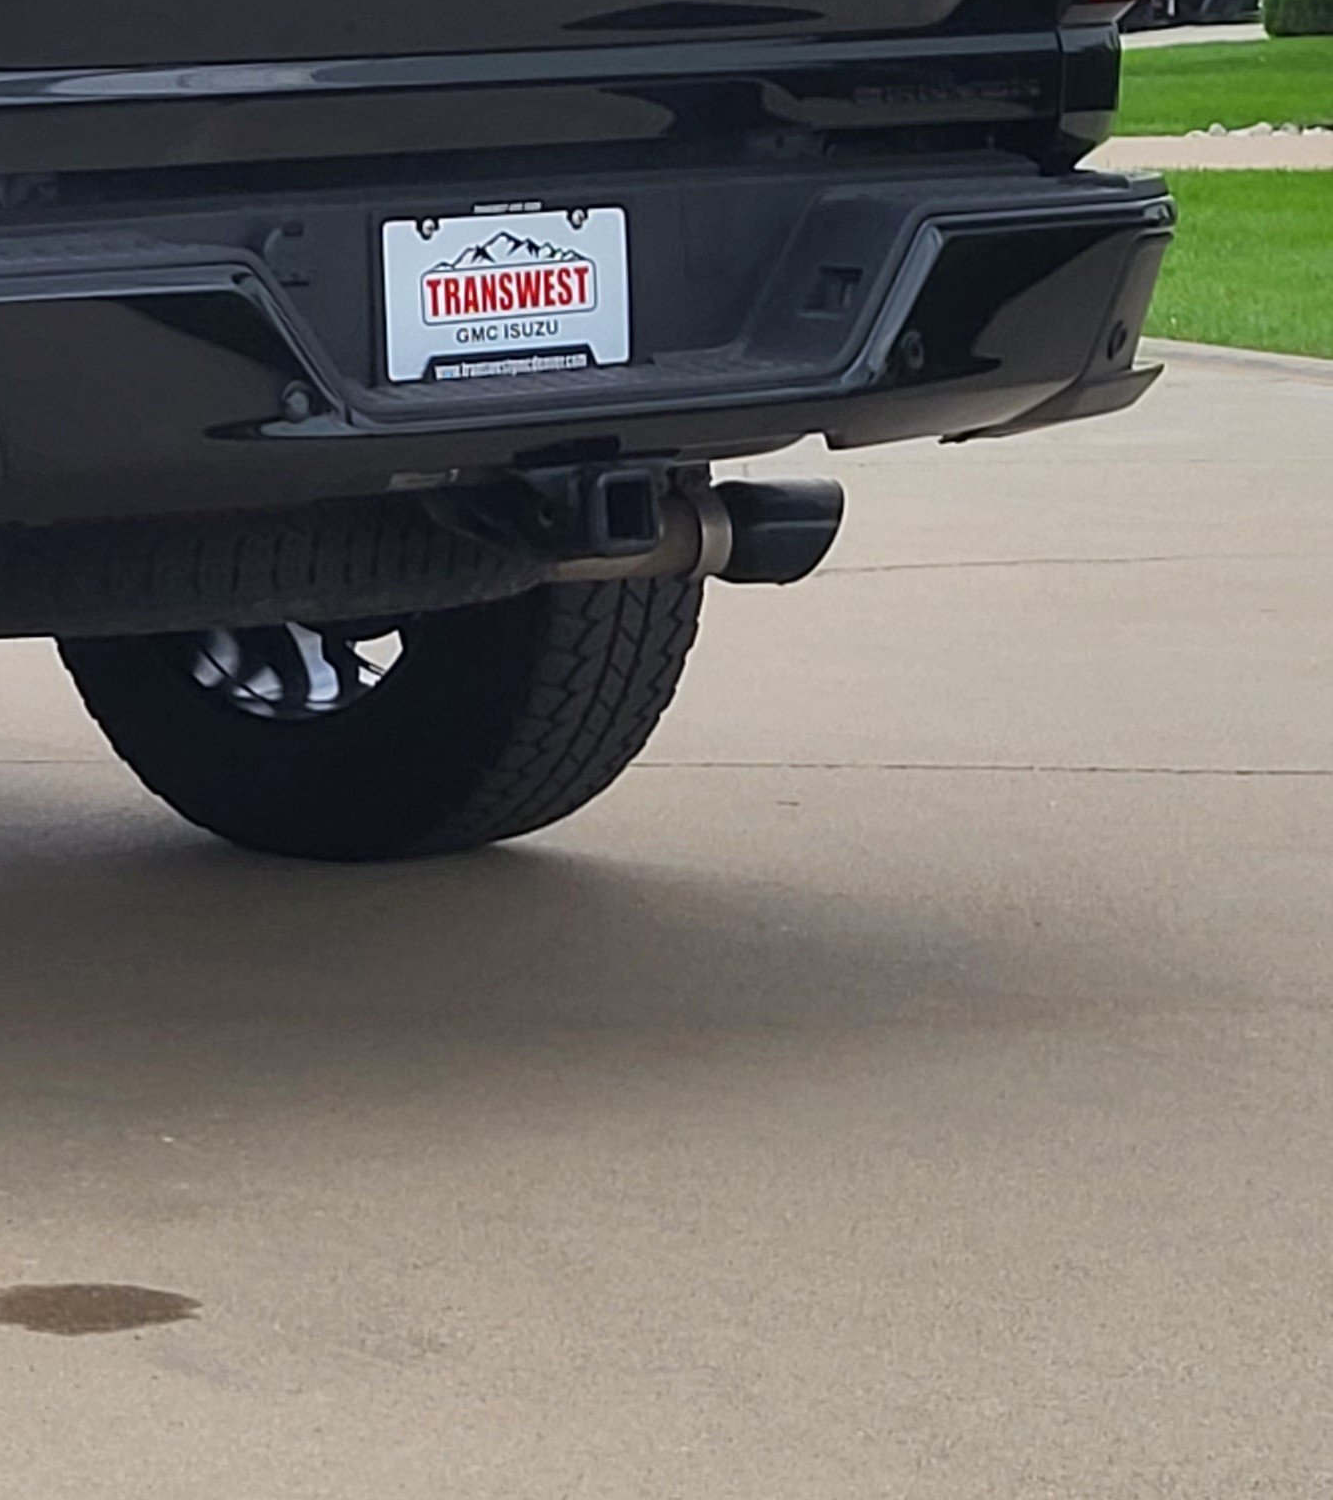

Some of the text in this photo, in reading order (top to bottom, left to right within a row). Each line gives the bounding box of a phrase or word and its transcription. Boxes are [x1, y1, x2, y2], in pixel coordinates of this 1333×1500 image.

[426, 266, 589, 317] TRANSWEST
[456, 320, 559, 343] GMC ISUZU
